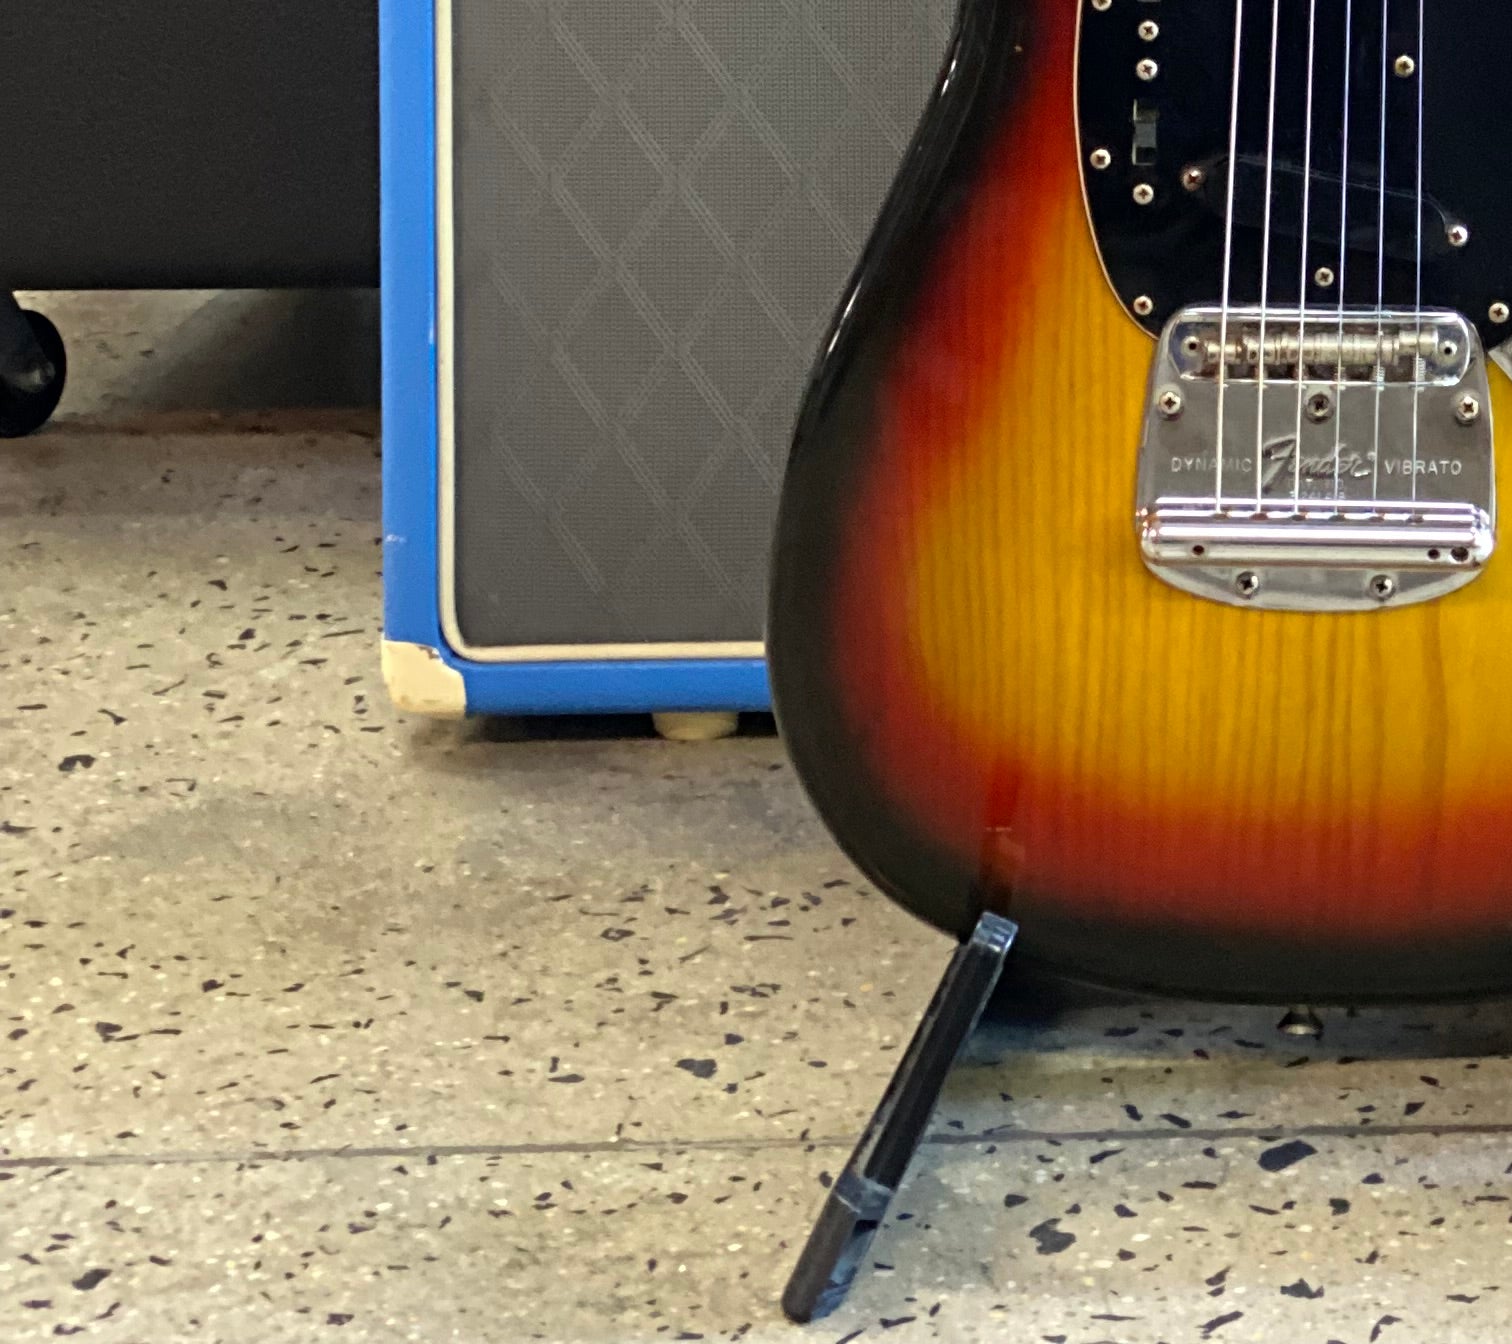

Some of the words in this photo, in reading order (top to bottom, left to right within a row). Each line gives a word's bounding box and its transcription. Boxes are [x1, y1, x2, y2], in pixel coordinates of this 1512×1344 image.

[1171, 457, 1253, 472] DYNAMIC
[1262, 433, 1373, 494] Fender
[1384, 457, 1462, 475] VIBRATO
